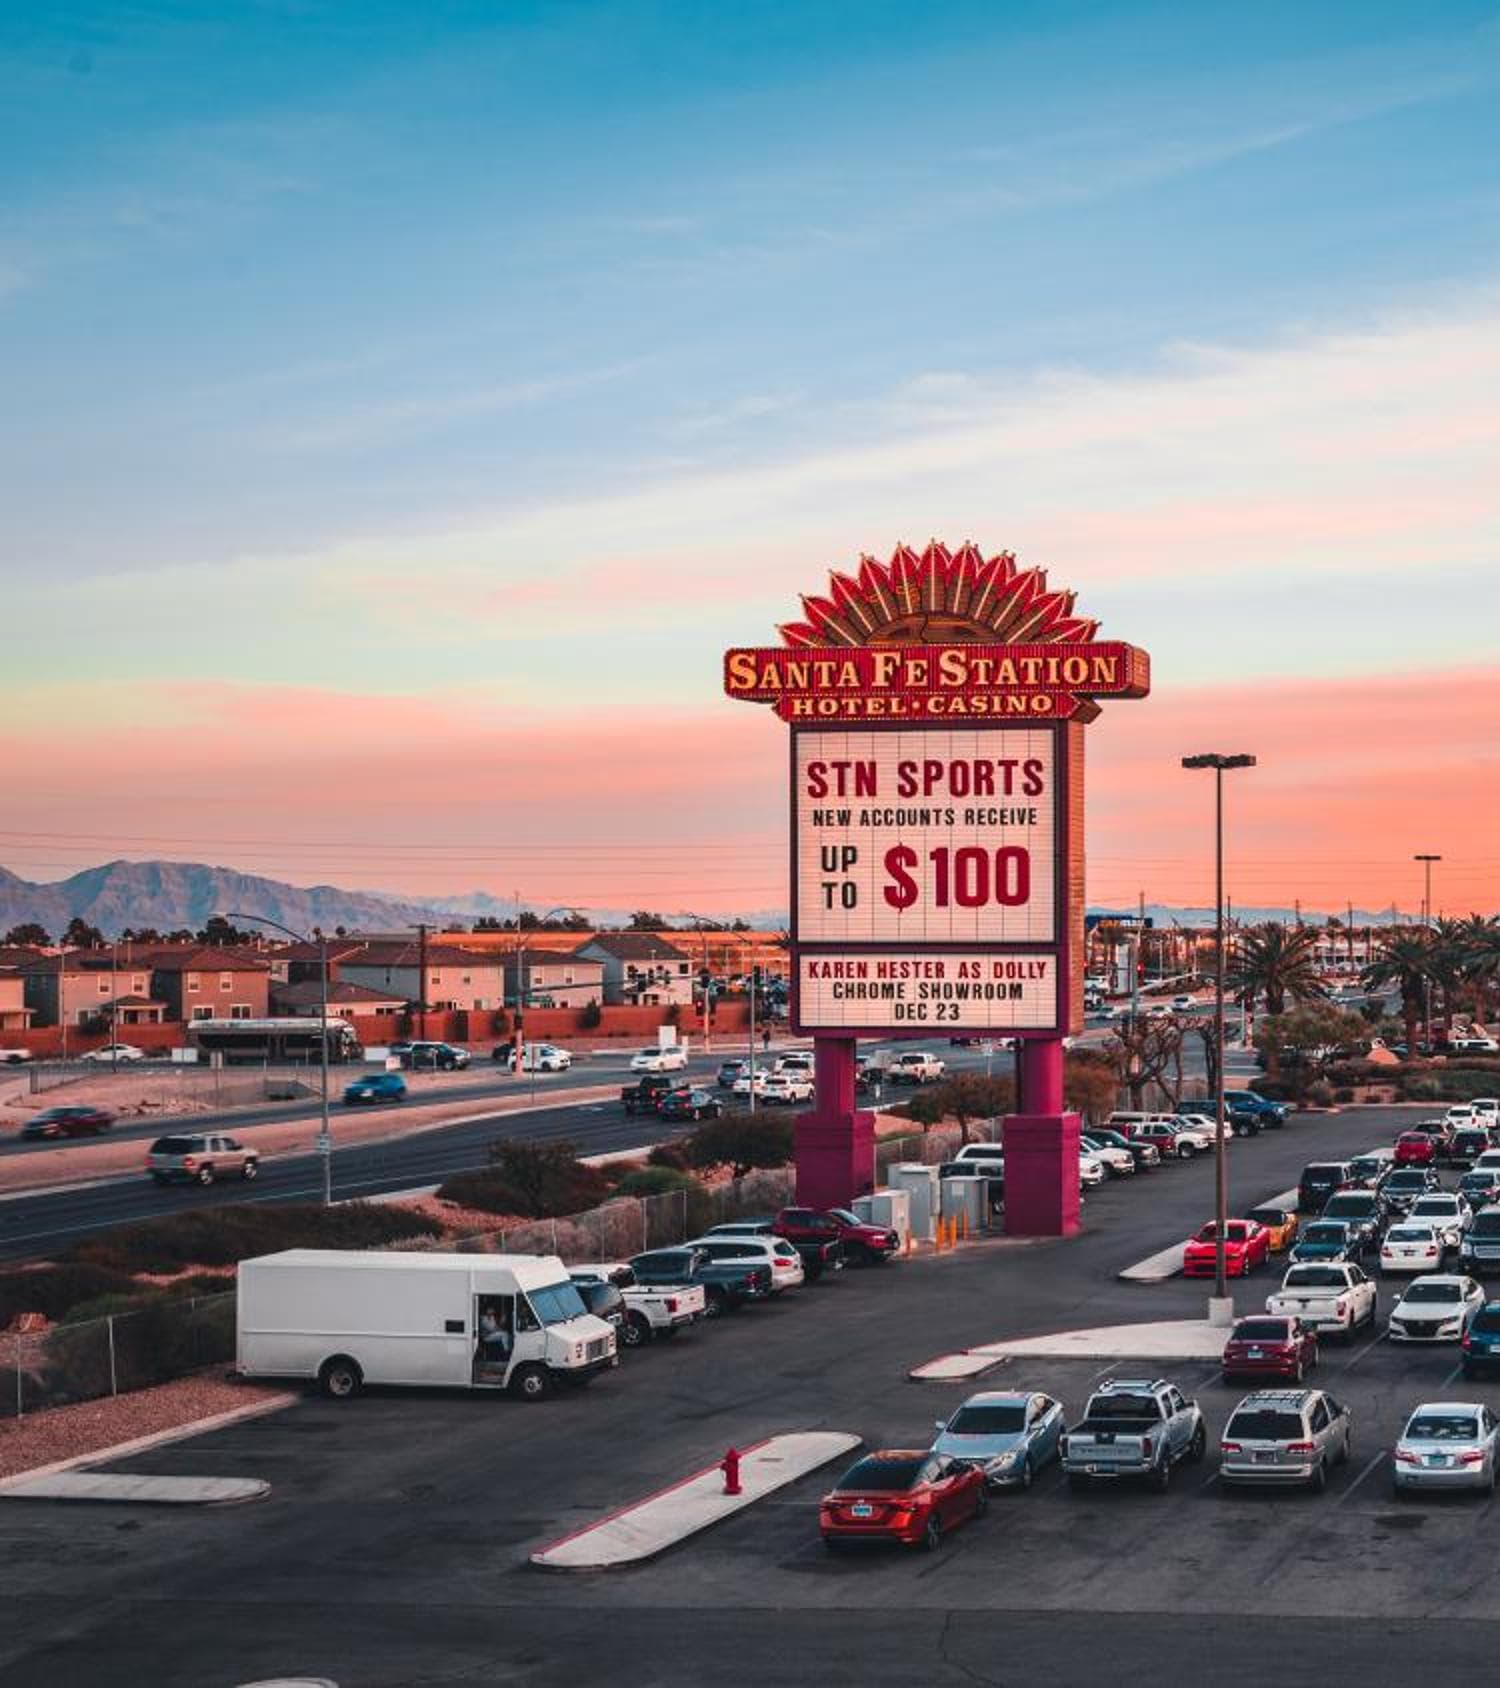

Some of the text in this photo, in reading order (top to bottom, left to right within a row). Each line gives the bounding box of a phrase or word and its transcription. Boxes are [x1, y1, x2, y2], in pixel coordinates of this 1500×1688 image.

[728, 648, 1119, 690] SANTA FE STATION
[792, 694, 1054, 716] HOTEL CASINO
[807, 758, 1044, 798] STN SPORTS
[812, 807, 1038, 827] NEW ACCOUNTS RECEIVE
[820, 845, 858, 873] UP
[883, 842, 1031, 913] $100
[820, 881, 858, 910] TO
[809, 961, 1047, 979] KAREN HESTER AS DOLLY
[832, 982, 1024, 999] CHROME SHOWROOM
[895, 1003, 960, 1021] DEC 23
